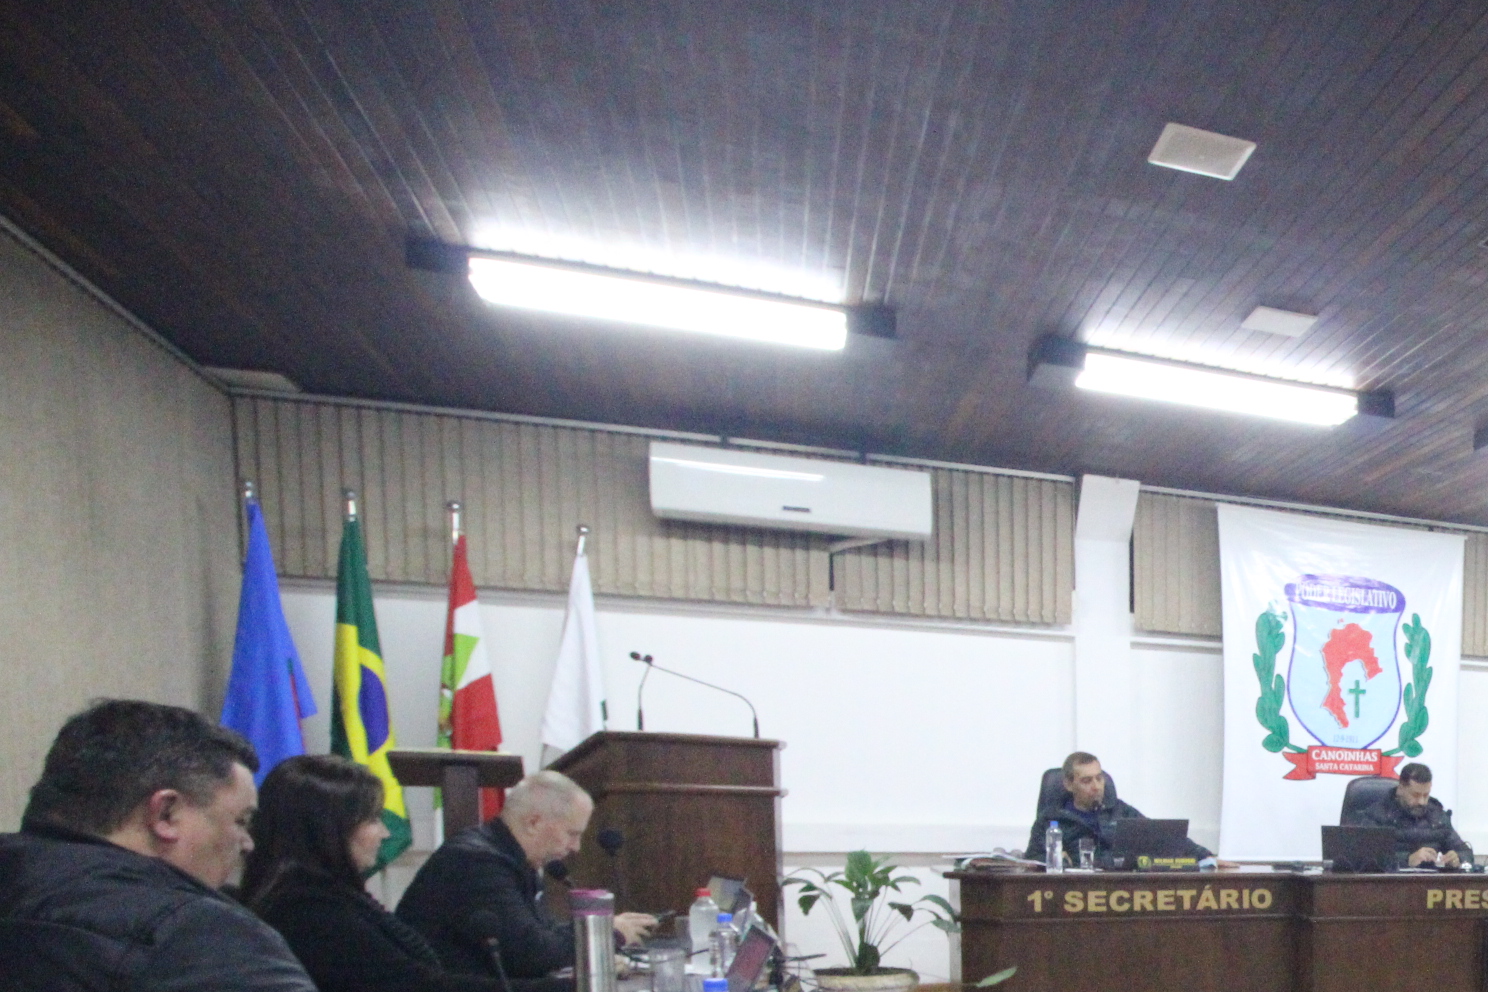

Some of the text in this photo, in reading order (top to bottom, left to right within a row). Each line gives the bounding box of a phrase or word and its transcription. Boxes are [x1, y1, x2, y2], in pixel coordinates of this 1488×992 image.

[1331, 586, 1398, 609] LEGISLATIVO
[1312, 749, 1378, 762] CANOINHAS
[1315, 762, 1374, 771] SANTA CATARINA
[1064, 885, 1273, 912] SECRETÁRIO
